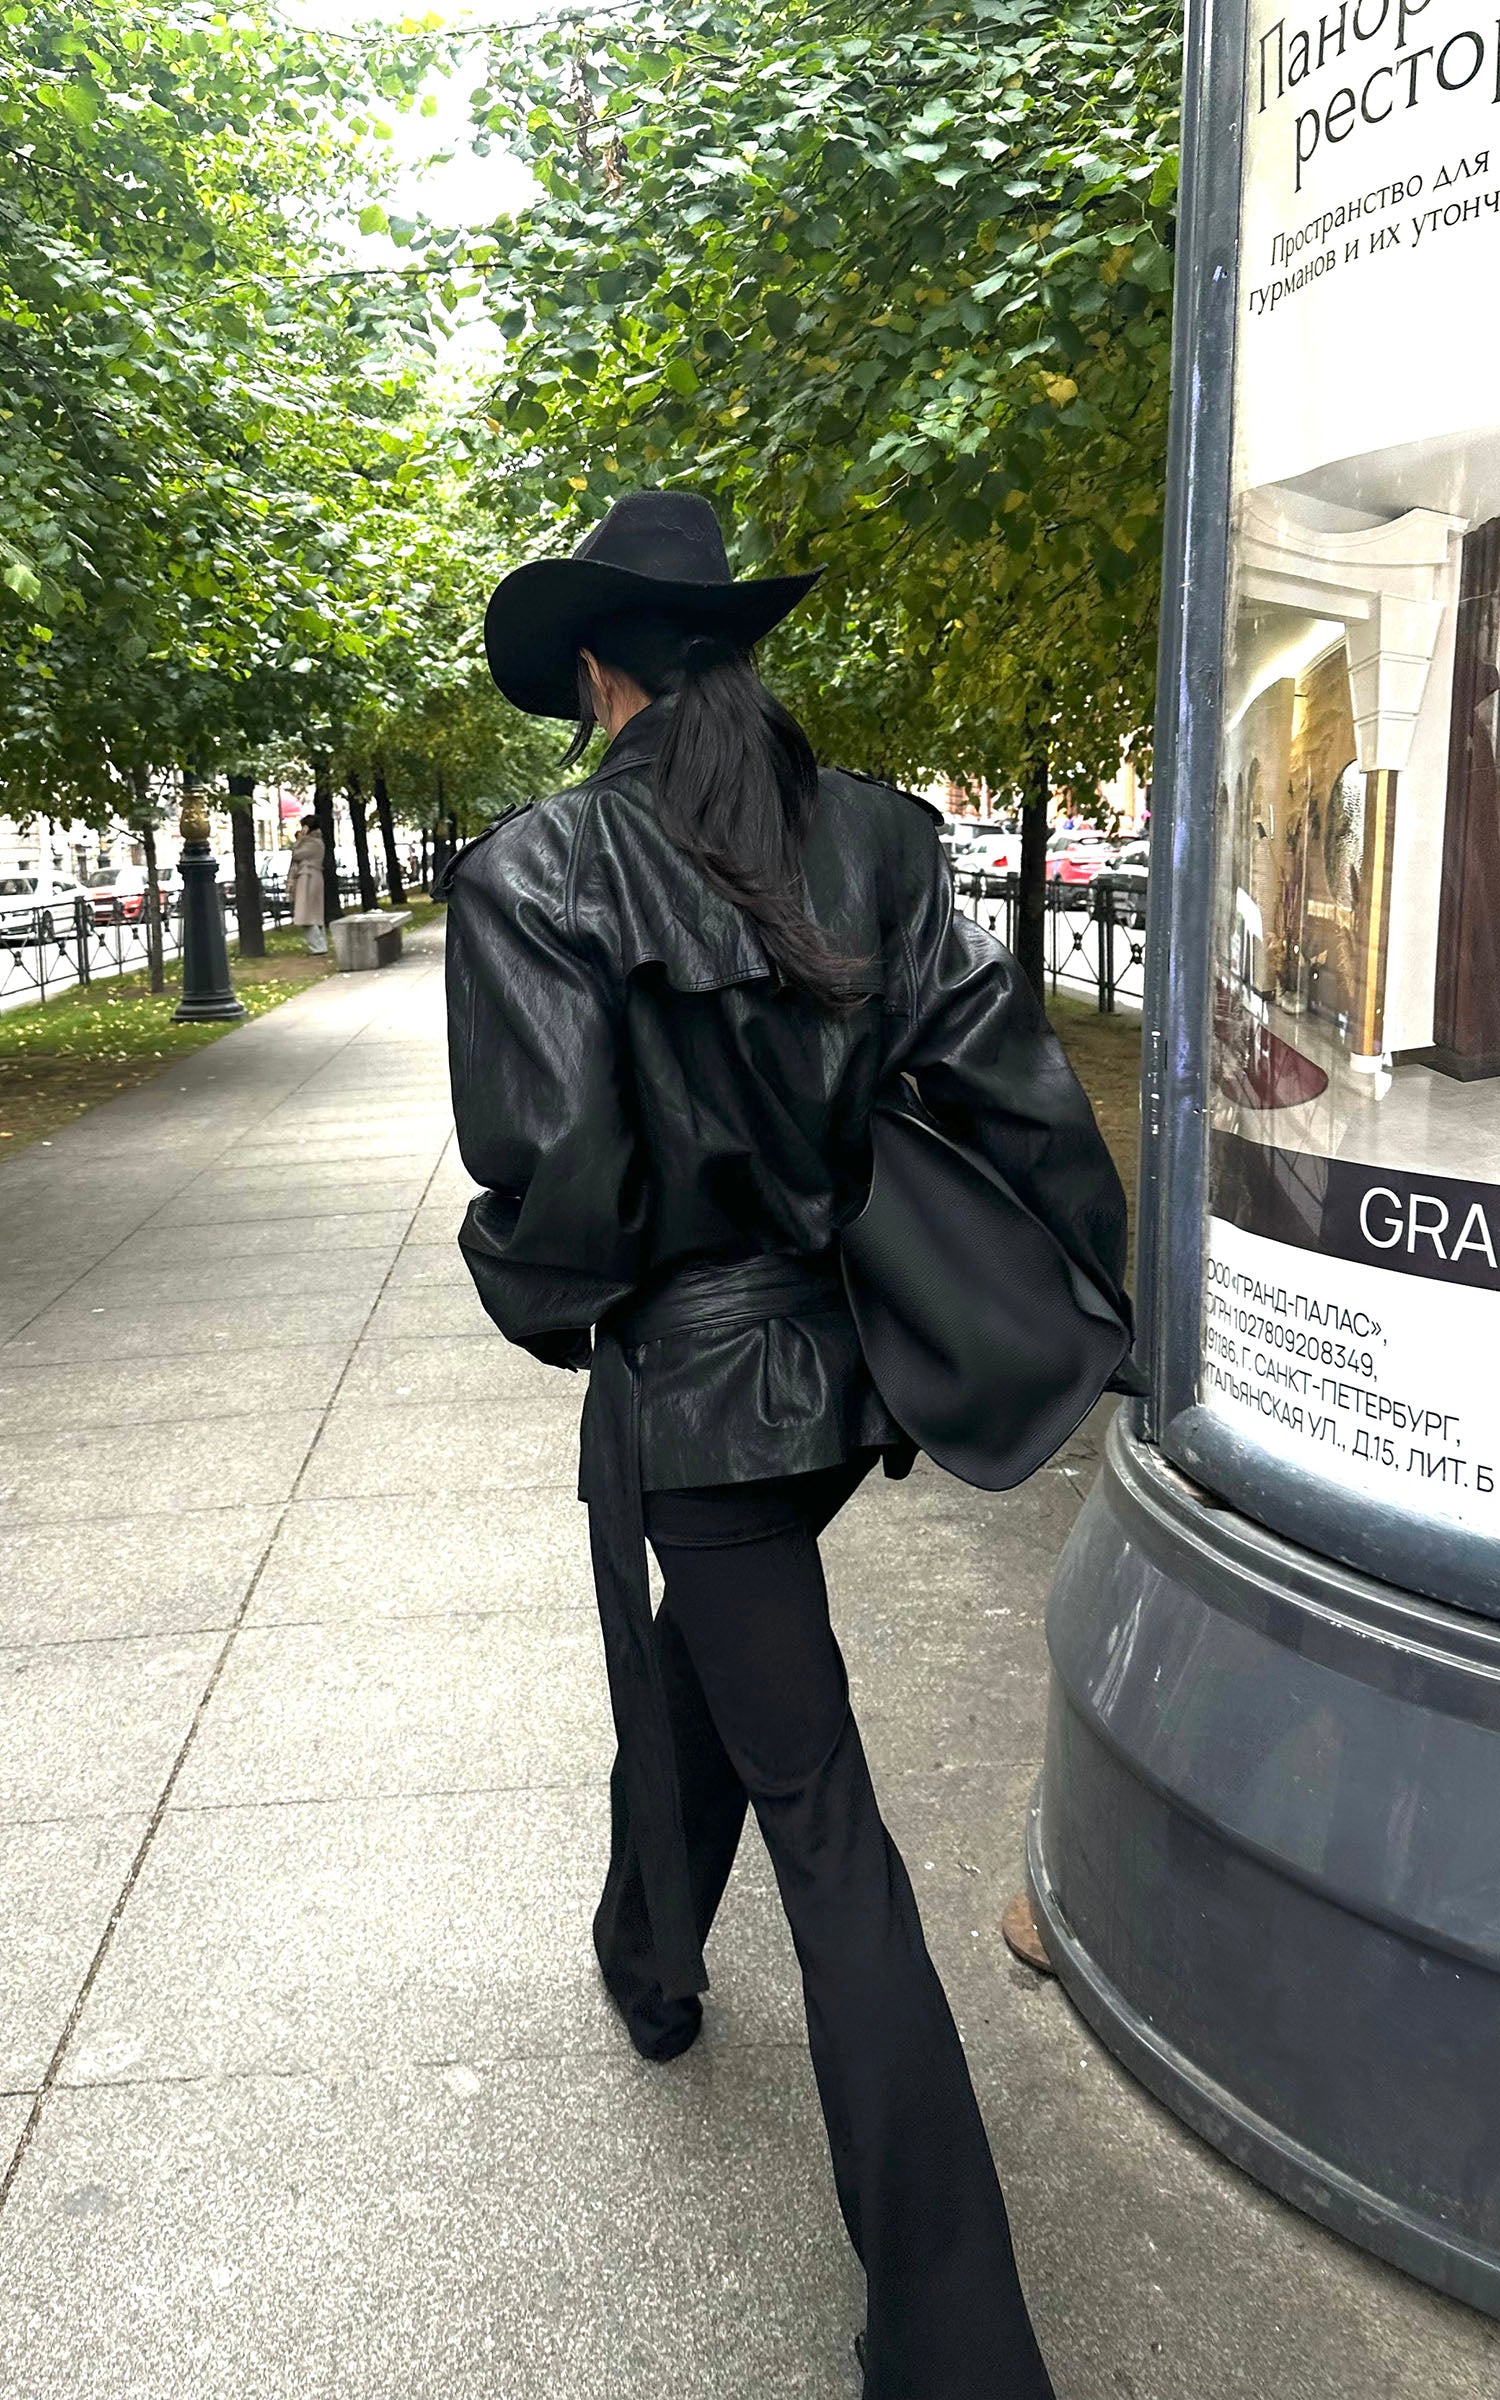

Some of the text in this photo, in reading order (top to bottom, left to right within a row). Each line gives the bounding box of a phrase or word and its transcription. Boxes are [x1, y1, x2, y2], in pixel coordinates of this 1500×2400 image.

[1294, 19, 1500, 193] ресто
[1249, 190, 1500, 316] гурманов и их утонч
[1271, 150, 1490, 269] Пространство для
[1358, 1186, 1498, 1268] GRA
[1206, 1258, 1387, 1346] ООО «ГРАНД-ПАЛАС»,
[1233, 1307, 1377, 1382] 1027809208349,
[1242, 1346, 1252, 1371] Г.
[1254, 1353, 1461, 1447] САНКТ-ПЕТЕРБУРГ,
[1308, 1412, 1346, 1452] УЛ.,
[1352, 1429, 1399, 1471] Д.15,
[1406, 1448, 1468, 1488] ЛИТ.
[1476, 1464, 1495, 1493] Б
